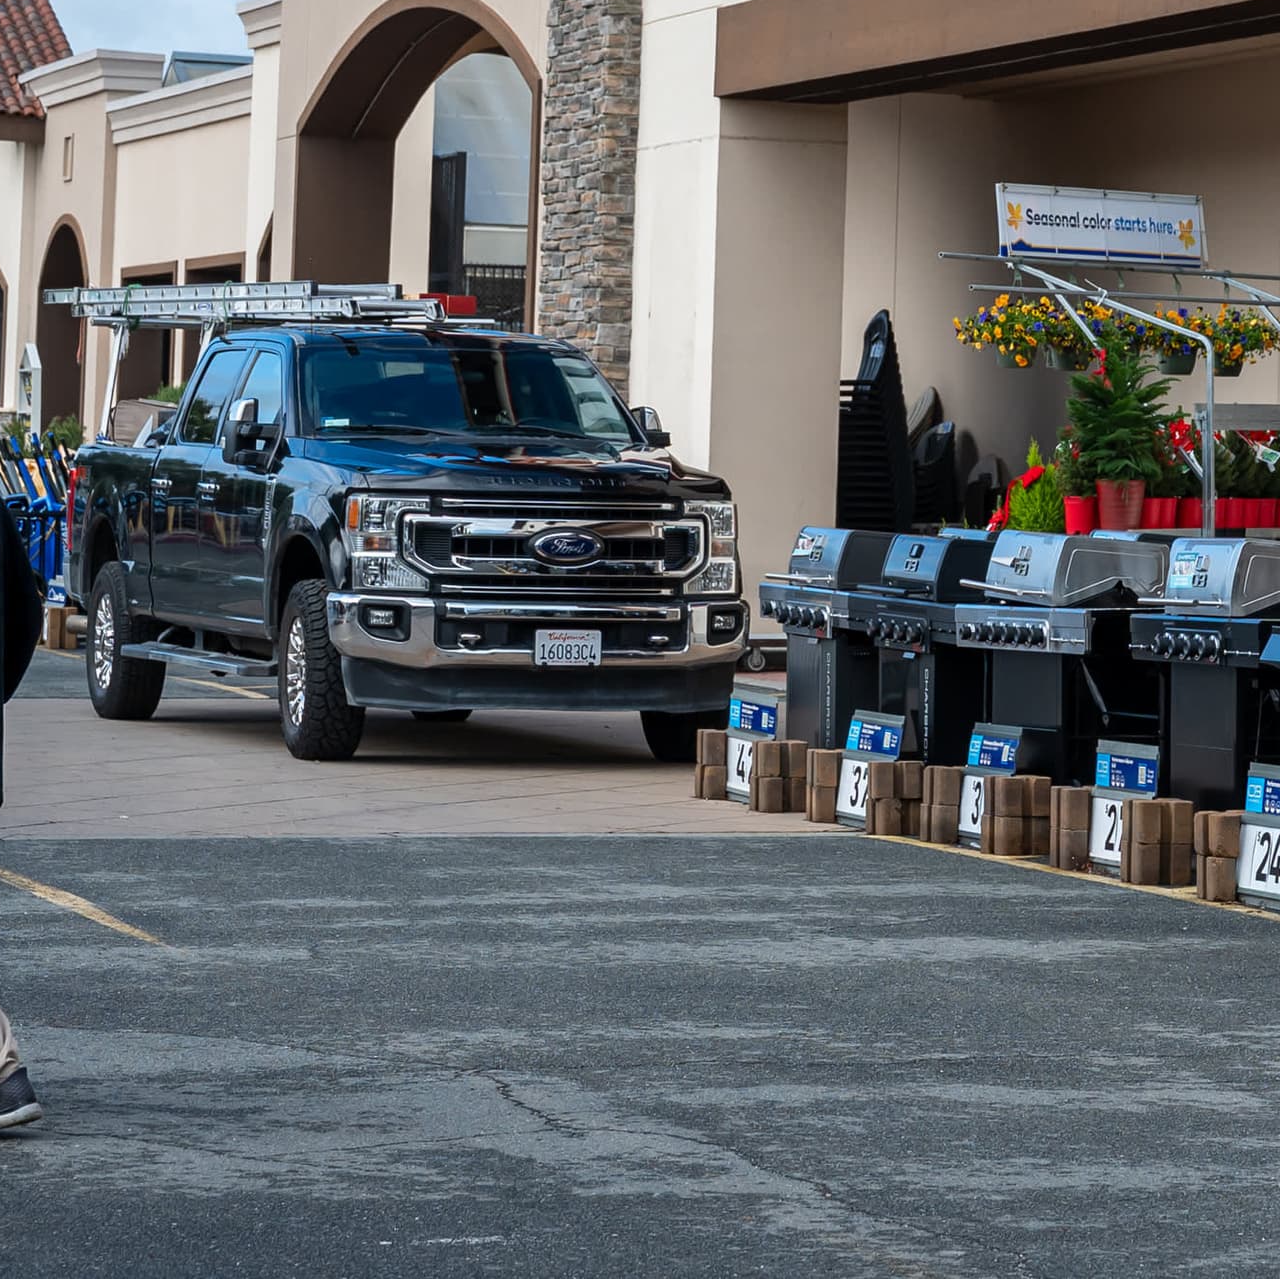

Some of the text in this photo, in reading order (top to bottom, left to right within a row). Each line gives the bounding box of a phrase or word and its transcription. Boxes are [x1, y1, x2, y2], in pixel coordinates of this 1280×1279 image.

[1026, 208, 1080, 228] Seasonal
[1082, 212, 1112, 230] color
[1114, 216, 1147, 233] starts
[551, 538, 585, 554] Ford
[540, 643, 596, 660] 16083C4
